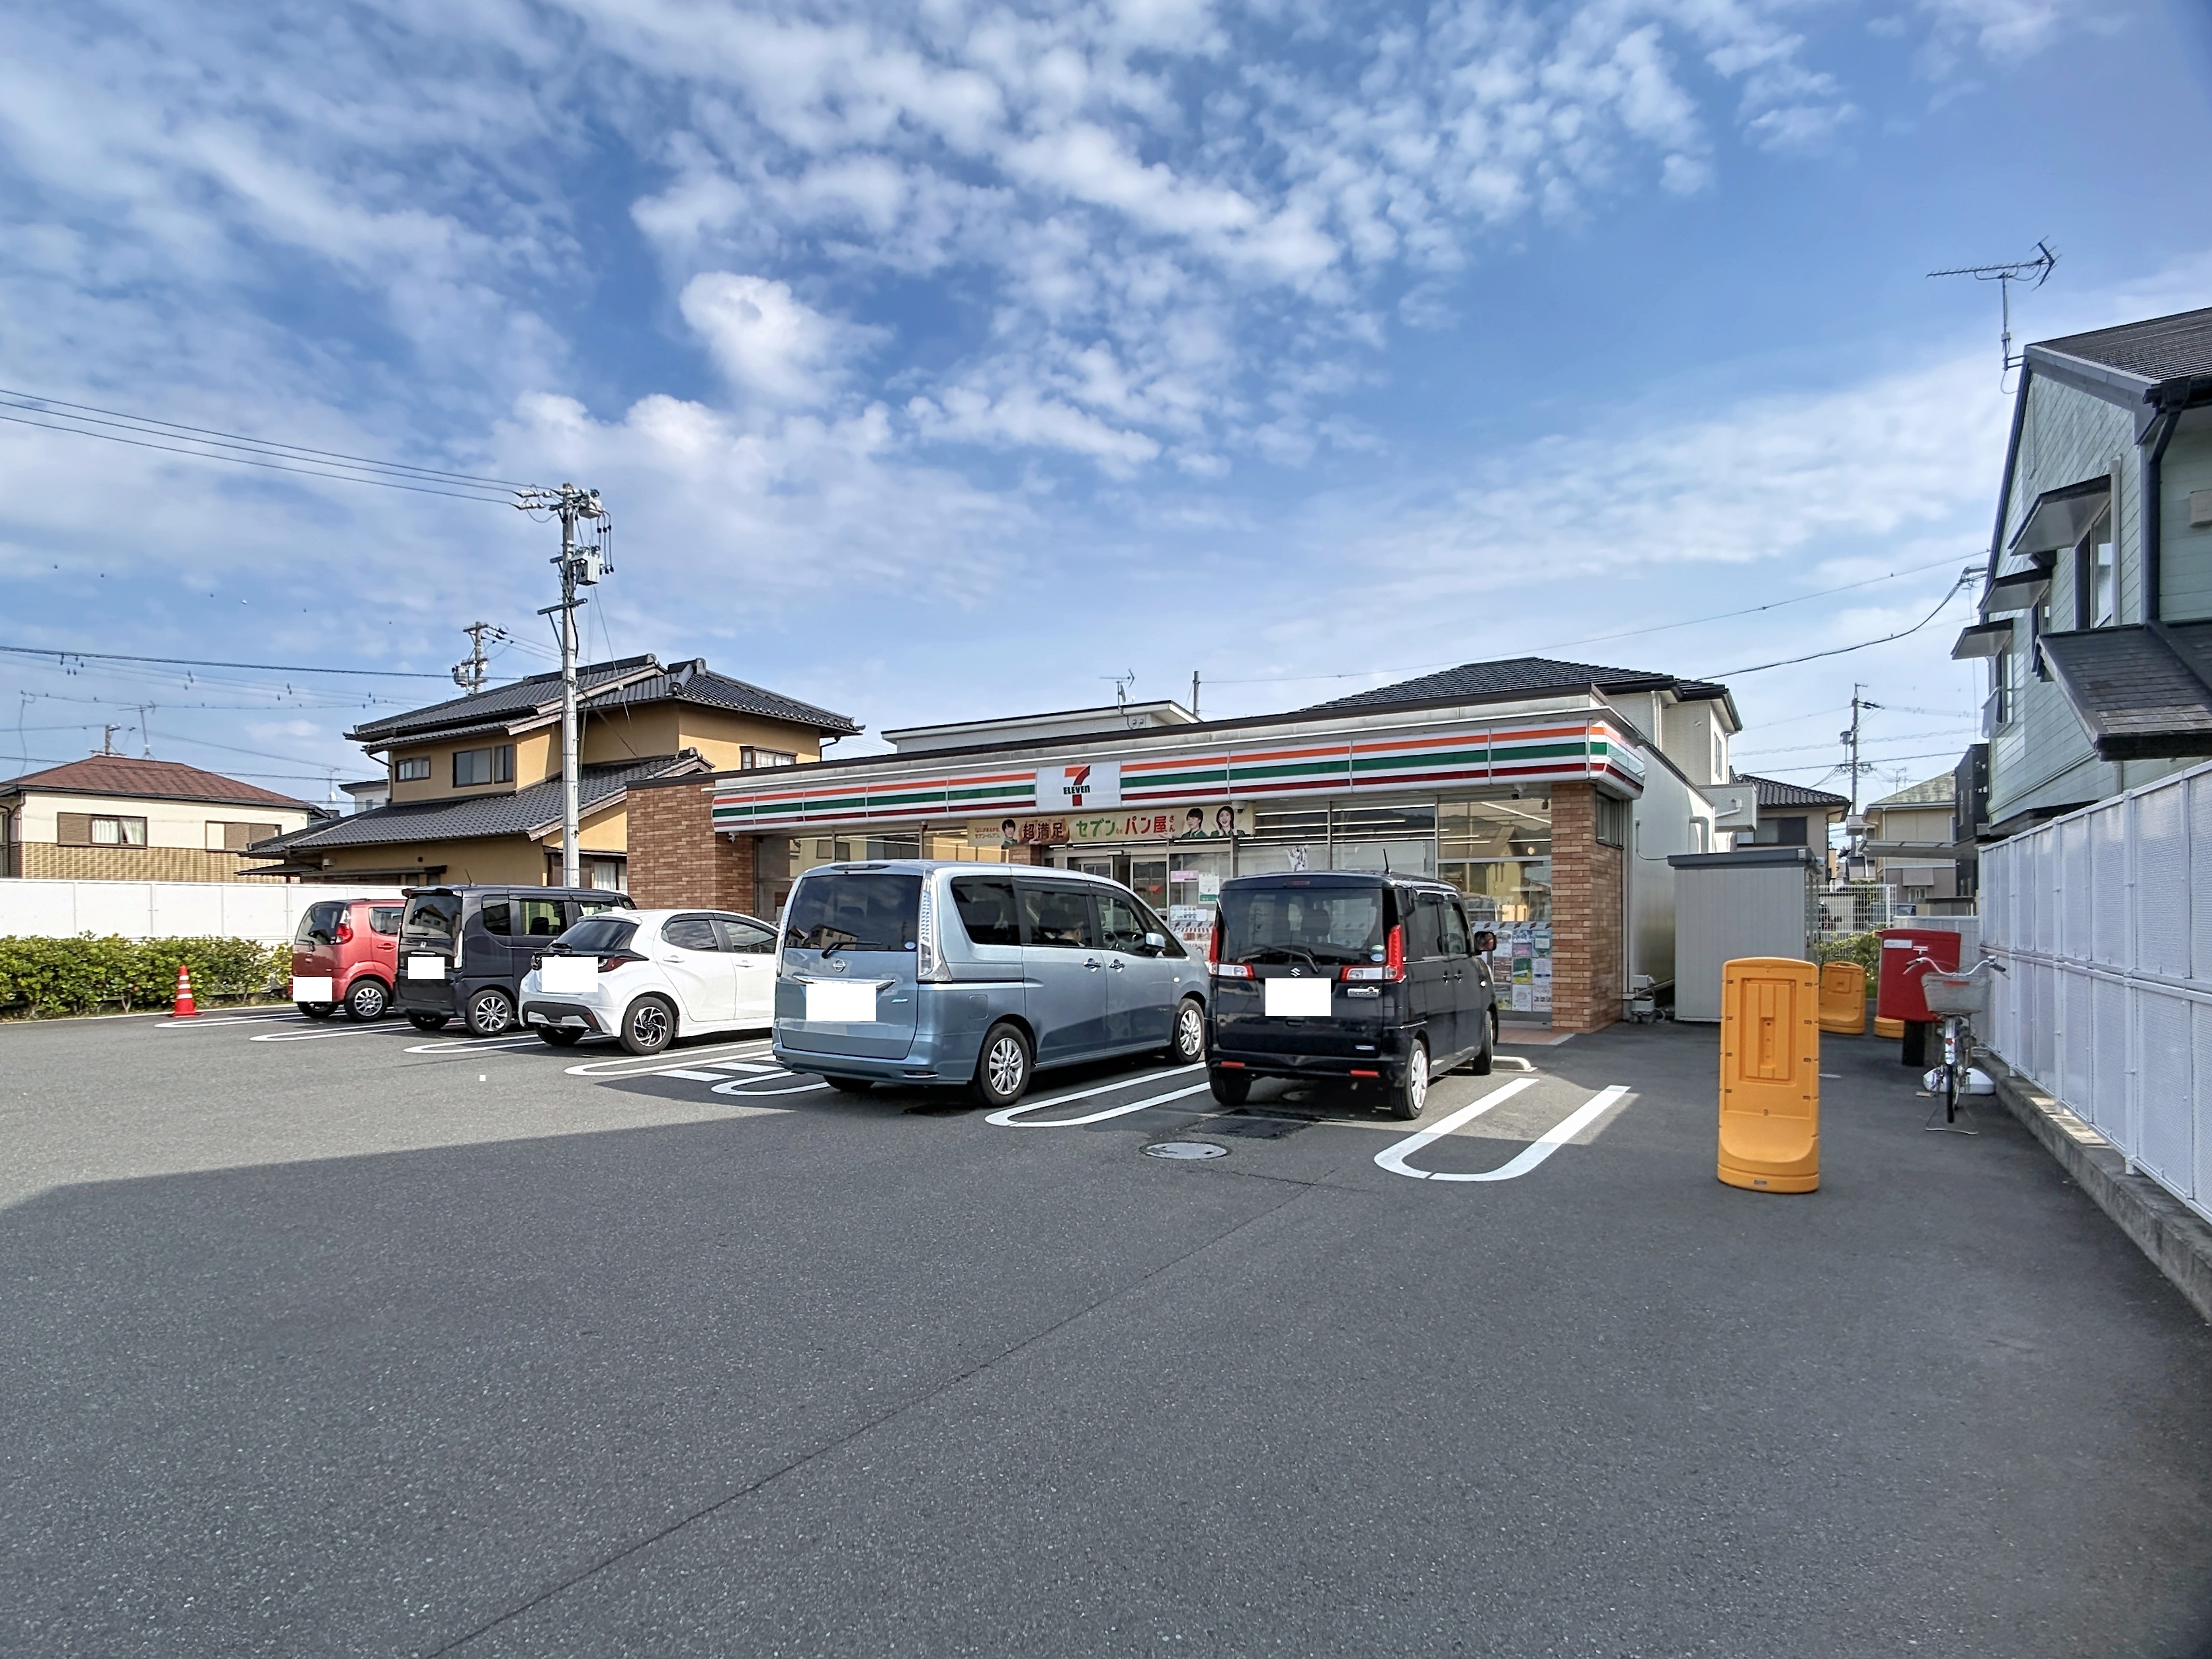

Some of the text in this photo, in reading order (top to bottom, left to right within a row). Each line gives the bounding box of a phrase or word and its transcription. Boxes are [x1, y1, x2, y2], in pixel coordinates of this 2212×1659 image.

[1064, 765, 1091, 807] 7
[1023, 822, 1064, 839] 超満足
